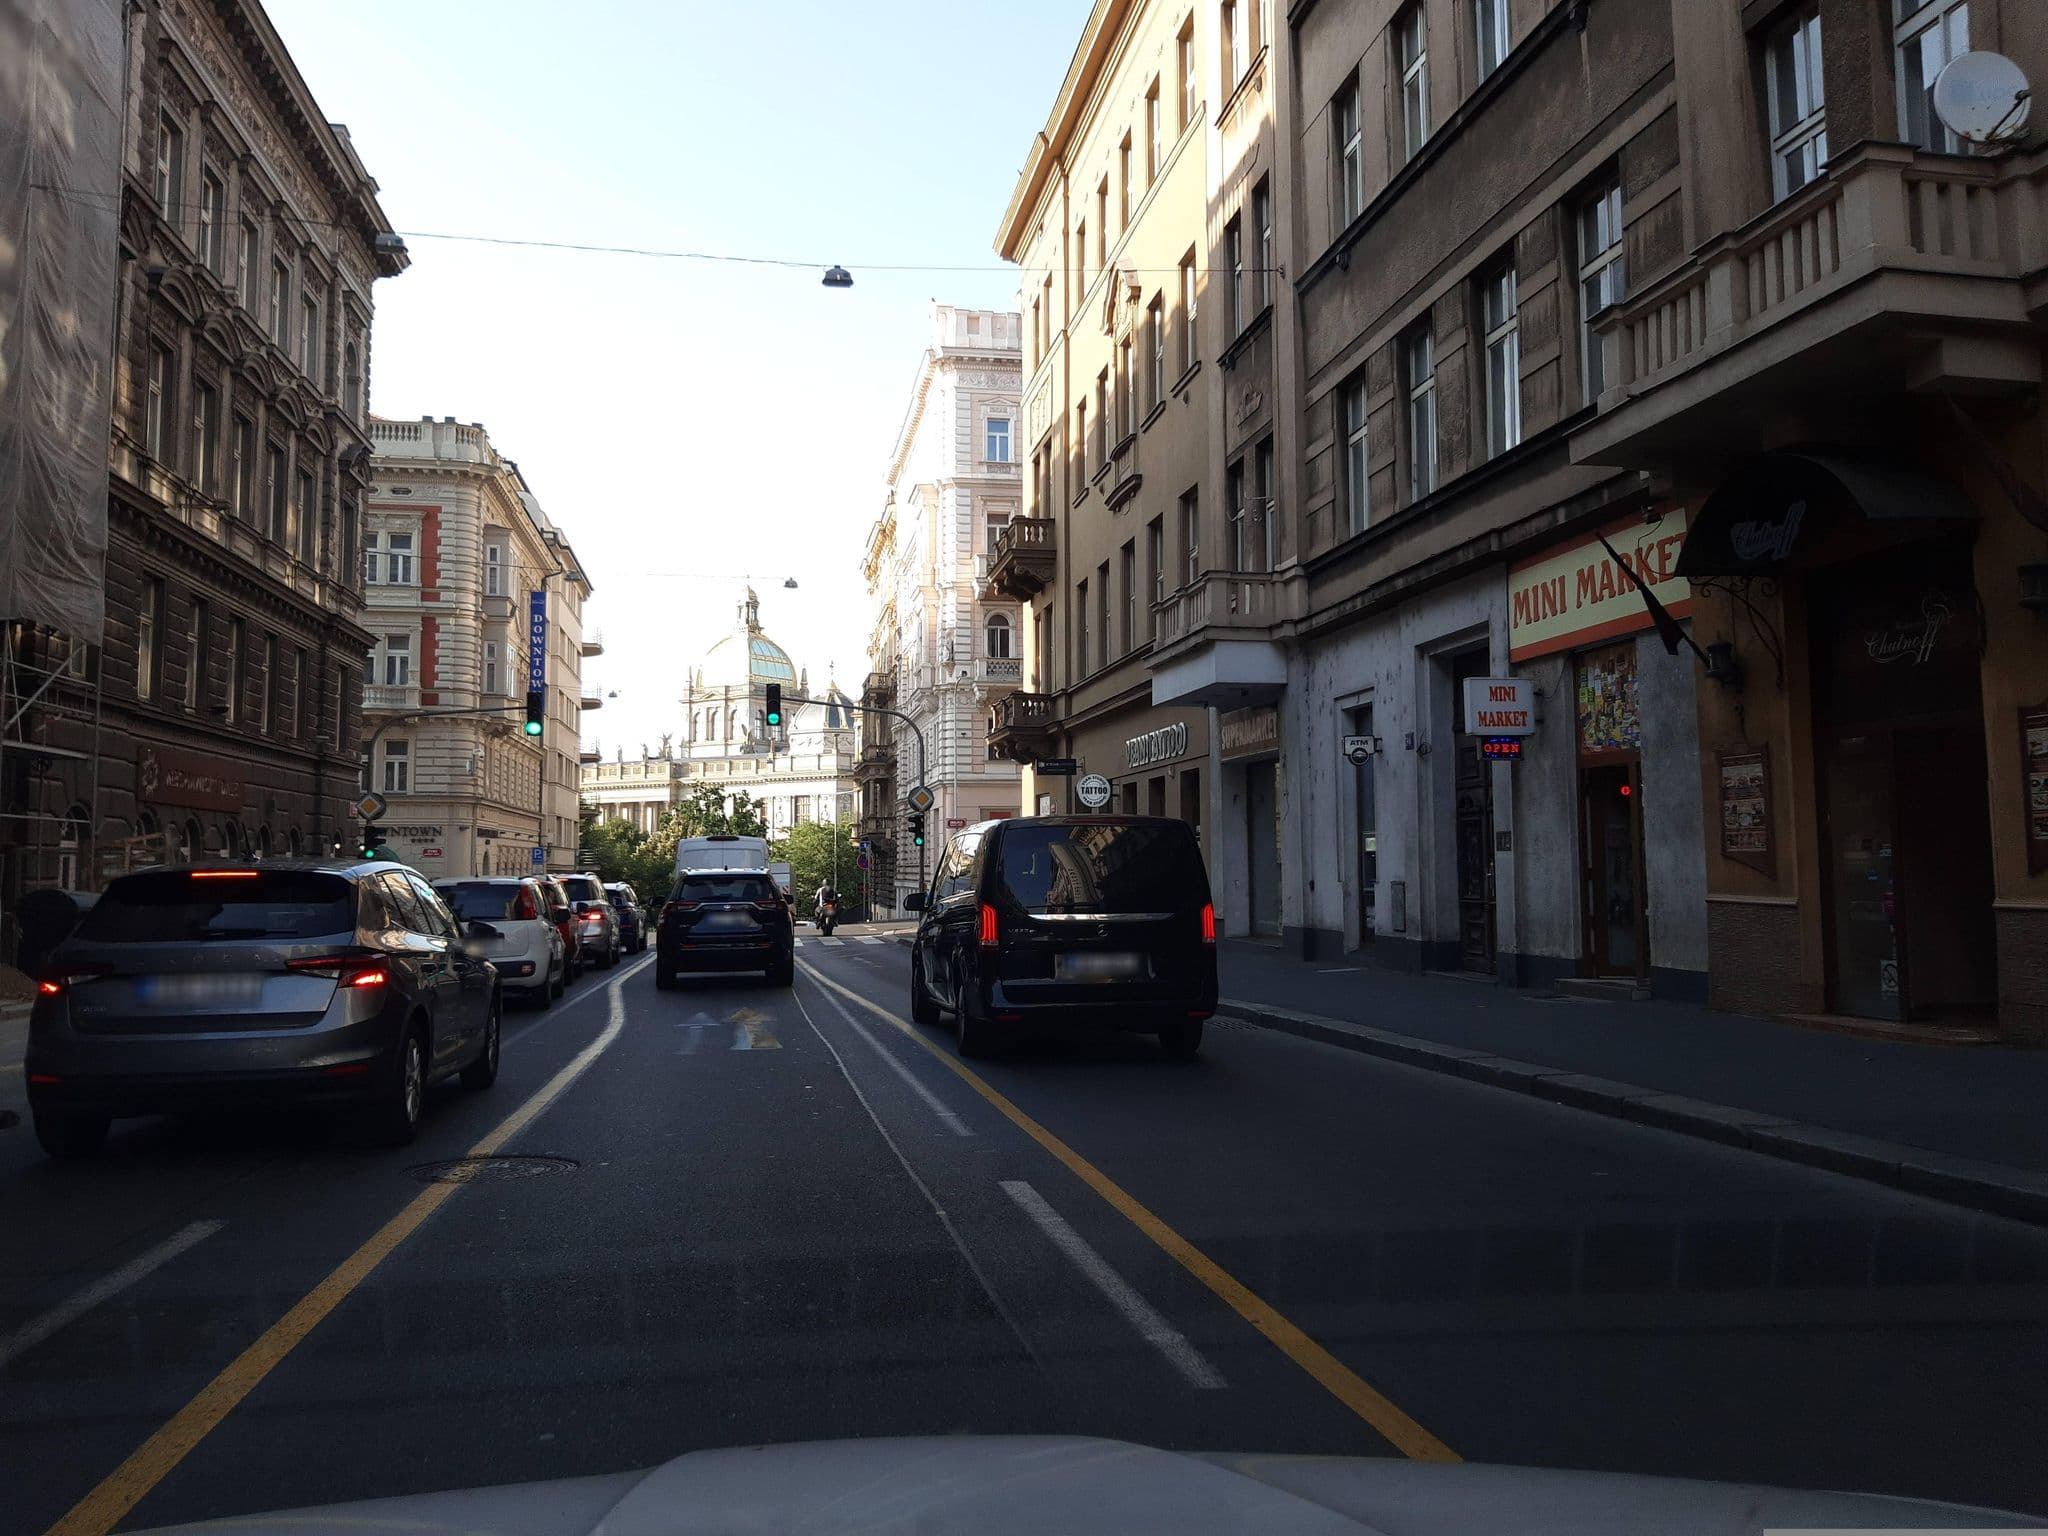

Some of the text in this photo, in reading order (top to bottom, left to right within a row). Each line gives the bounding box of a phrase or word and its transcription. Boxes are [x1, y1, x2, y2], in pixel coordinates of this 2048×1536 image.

[1513, 574, 1567, 629] MINI
[532, 614, 544, 693] DOWNTOW
[1489, 686, 1516, 702] MINI
[1478, 711, 1528, 727] MARKET
[1148, 722, 1187, 763] TATTOO
[1484, 744, 1520, 753] OPEN
[1081, 786, 1108, 795] TATTOO
[534, 848, 543, 859] P
